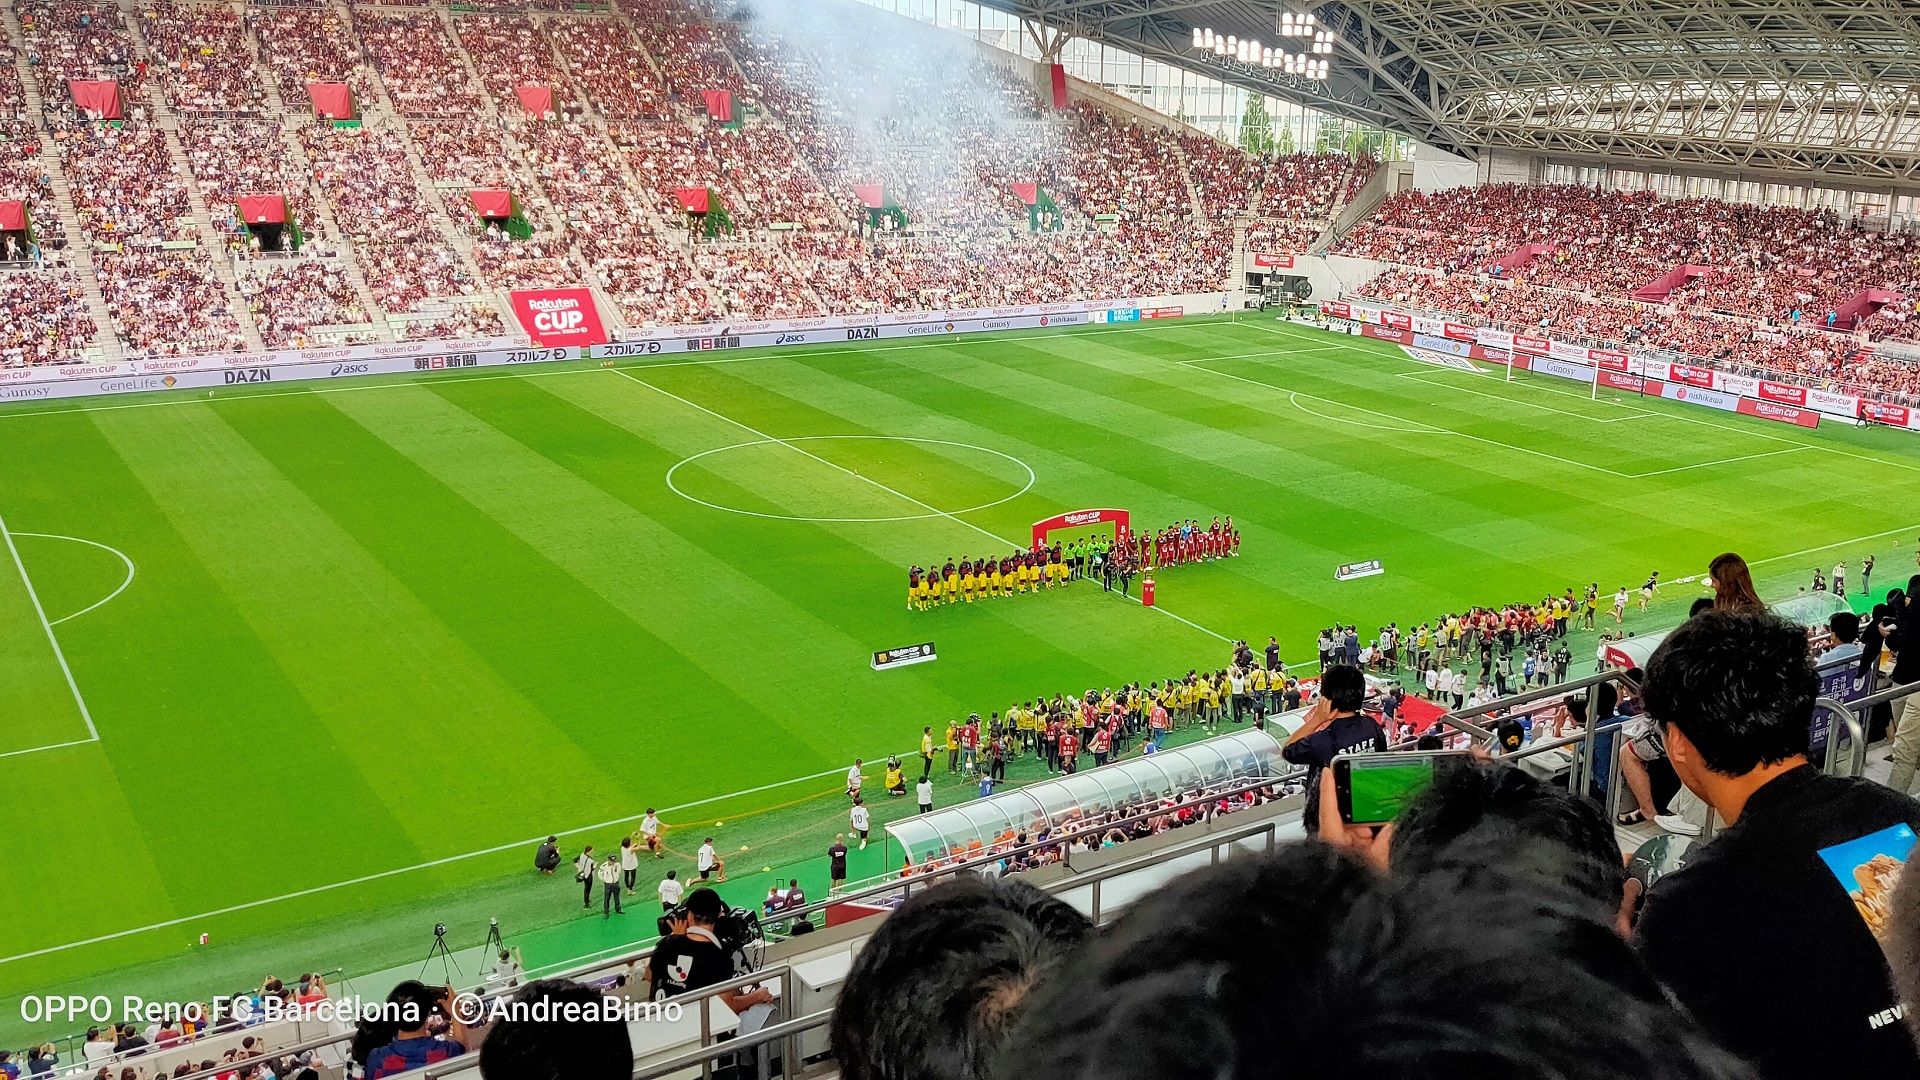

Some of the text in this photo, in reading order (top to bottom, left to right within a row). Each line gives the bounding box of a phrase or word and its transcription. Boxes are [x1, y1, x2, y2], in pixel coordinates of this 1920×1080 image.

[528, 298, 579, 310] Rakuten
[534, 310, 583, 331] CUP
[894, 313, 918, 321] Rakuten
[1050, 315, 1078, 324] nishikawa
[732, 323, 771, 332] Rakuten CUP
[788, 320, 814, 328] Rakuten
[982, 319, 1011, 329] Gunosy
[700, 326, 714, 334] CUP
[848, 327, 879, 340] DAZN
[908, 325, 943, 335] GeneLife
[446, 340, 492, 350] Rakuten CUP
[687, 336, 740, 351] 朝日新聞
[1422, 338, 1451, 350] GeneLife
[301, 350, 351, 360] Rakuten CUP
[375, 345, 423, 355] Rakuten CUP
[144, 359, 199, 371] Rakuten CUP
[224, 355, 276, 365] Rakuten CUP
[414, 354, 477, 370] 朝日新聞
[60, 365, 117, 377] Rakuten CUP
[1547, 361, 1576, 377] Gunosy
[13, 371, 31, 379] CUP
[224, 368, 271, 385] DAZN
[1610, 374, 1634, 384] Rakuten
[100, 378, 158, 392] GeneLife
[1763, 383, 1802, 397] Rakuten CUP
[0, 386, 50, 398] Gunosy
[1689, 392, 1723, 405] nishikawa
[1812, 393, 1838, 404] Rakuten
[1756, 403, 1799, 418] Rakuten CUP
[1890, 407, 1904, 416] CUP
[1065, 513, 1088, 523] Rakuten
[1088, 511, 1101, 519] CUP
[1338, 737, 1376, 755] STAFF
[854, 814, 863, 824] 10
[700, 852, 704, 863] 7
